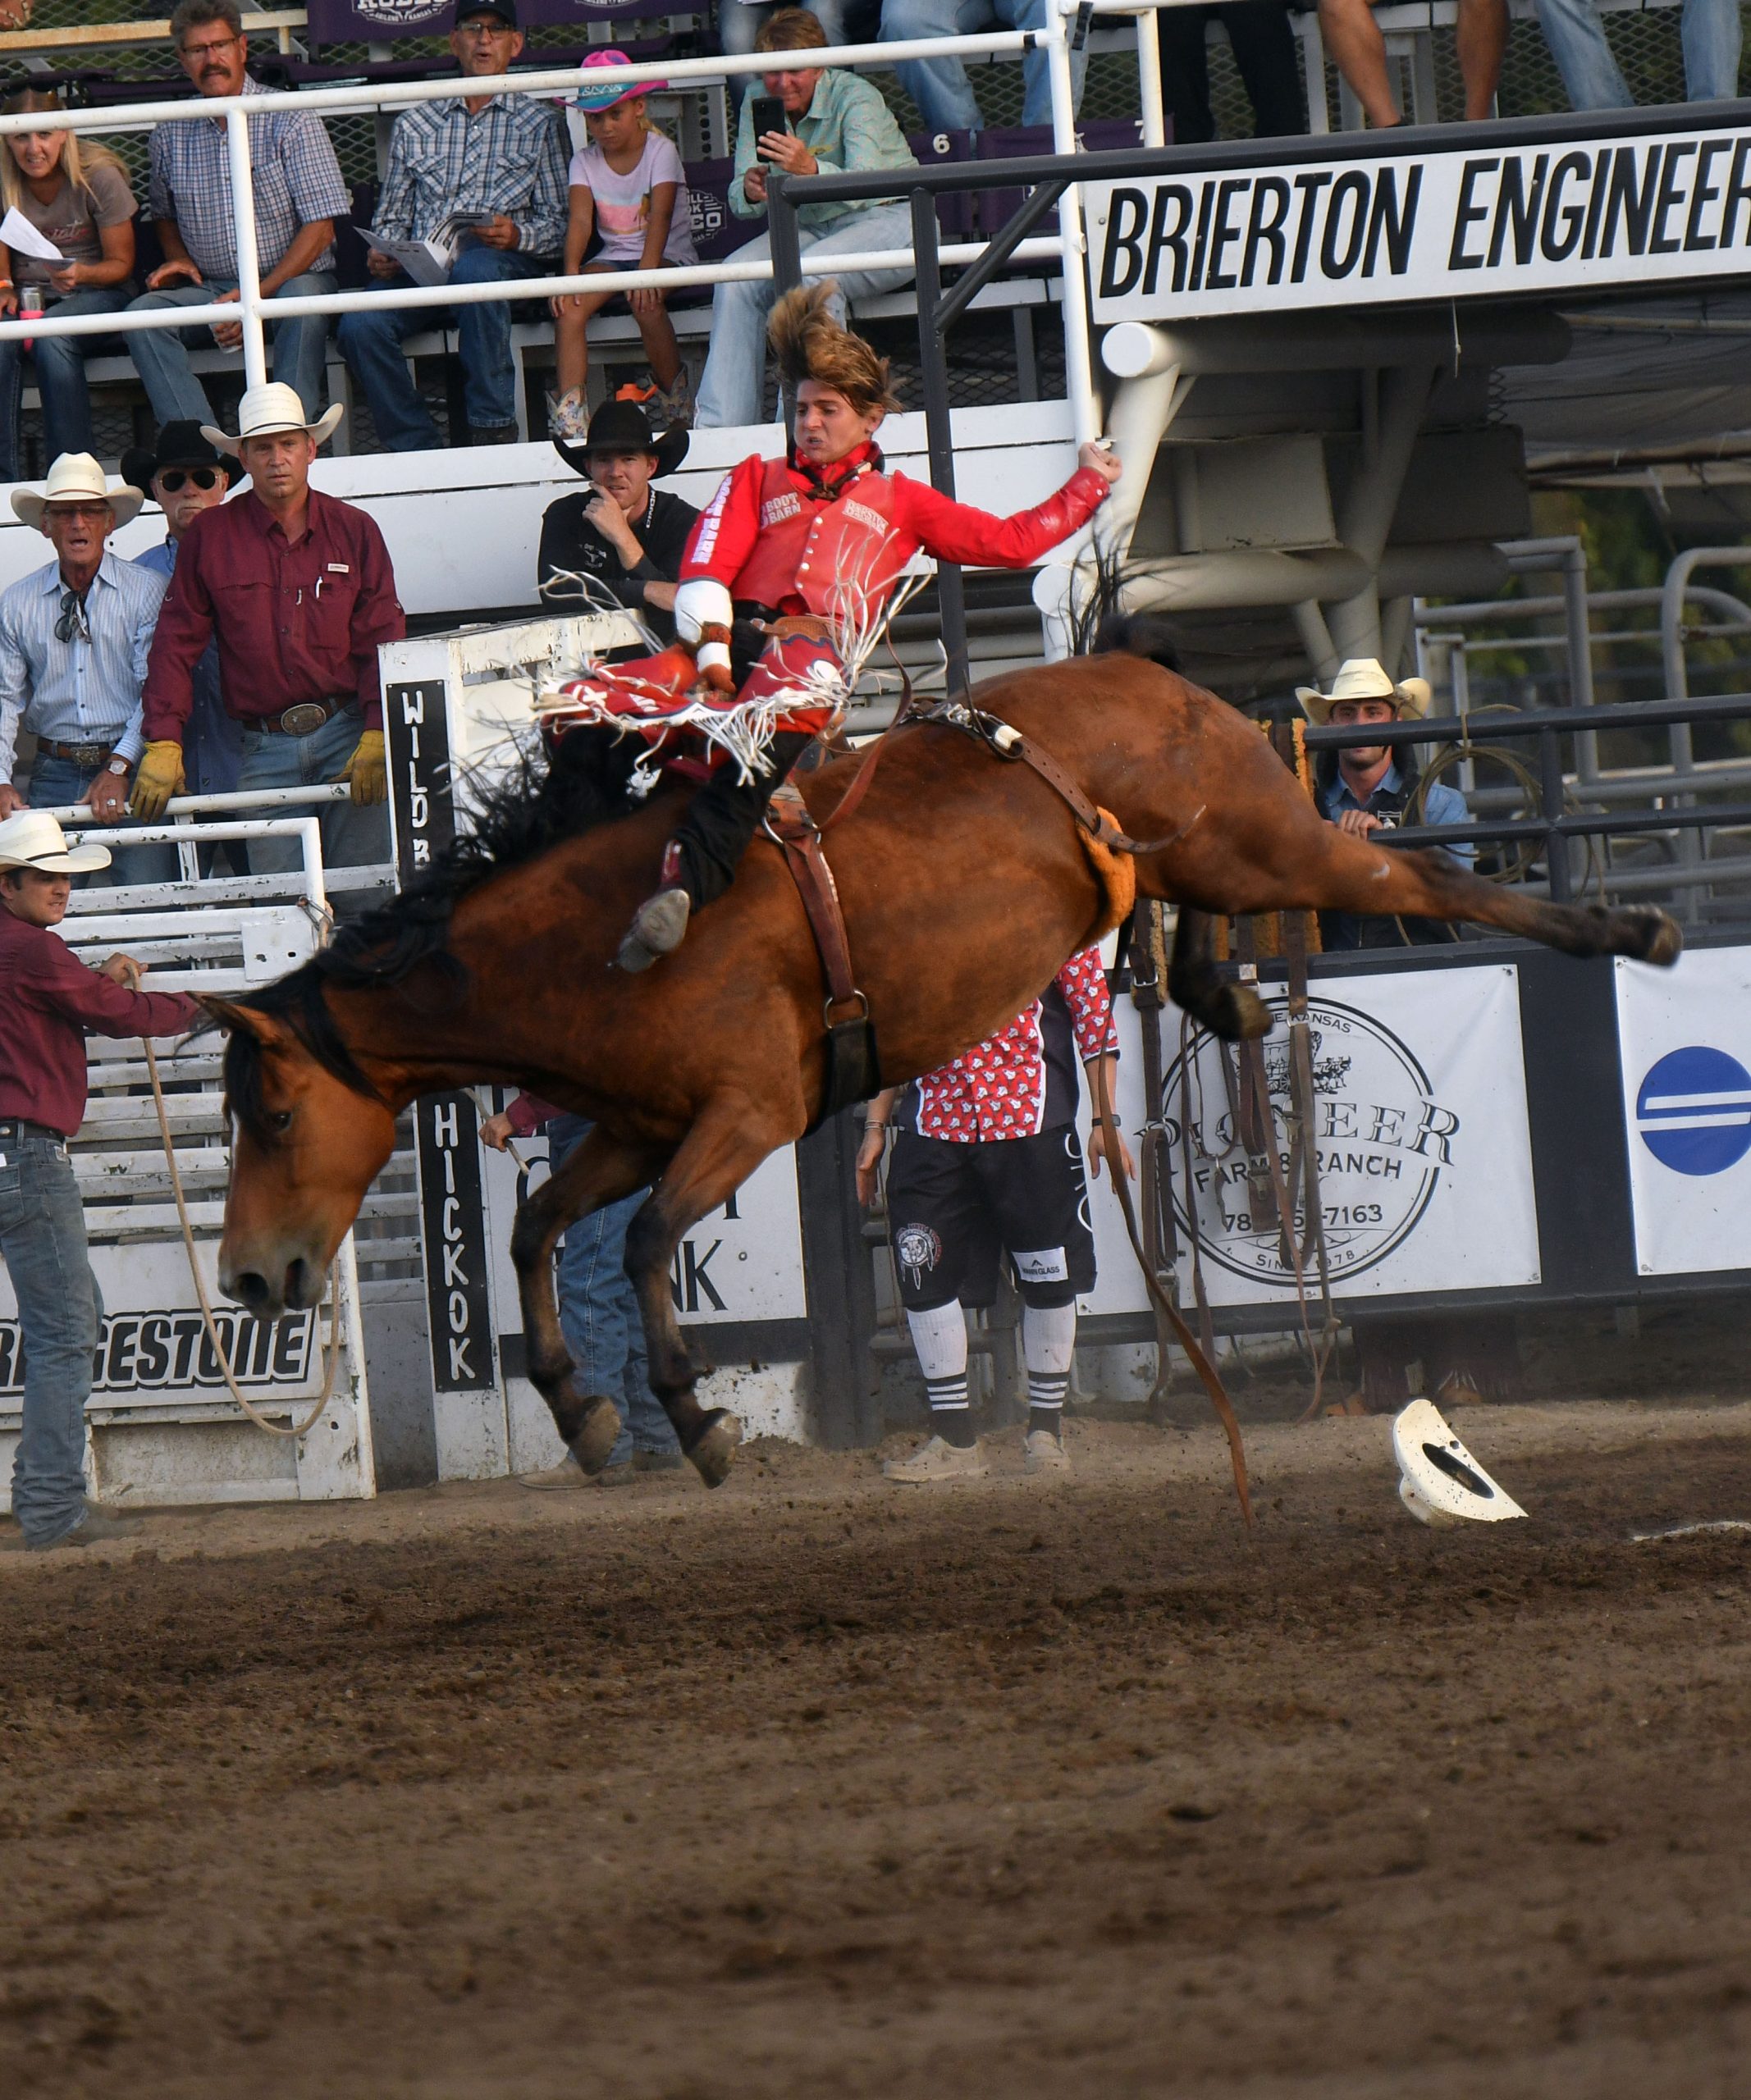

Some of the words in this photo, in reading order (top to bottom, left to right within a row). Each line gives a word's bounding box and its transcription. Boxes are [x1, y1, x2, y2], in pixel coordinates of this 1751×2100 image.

[933, 134, 950, 153] 6
[1100, 164, 1423, 298] BRIERTON
[765, 492, 798, 513] BOOT
[768, 502, 802, 524] BARN
[434, 1102, 477, 1382] HICKOK
[1256, 1253, 1307, 1271] SIN
